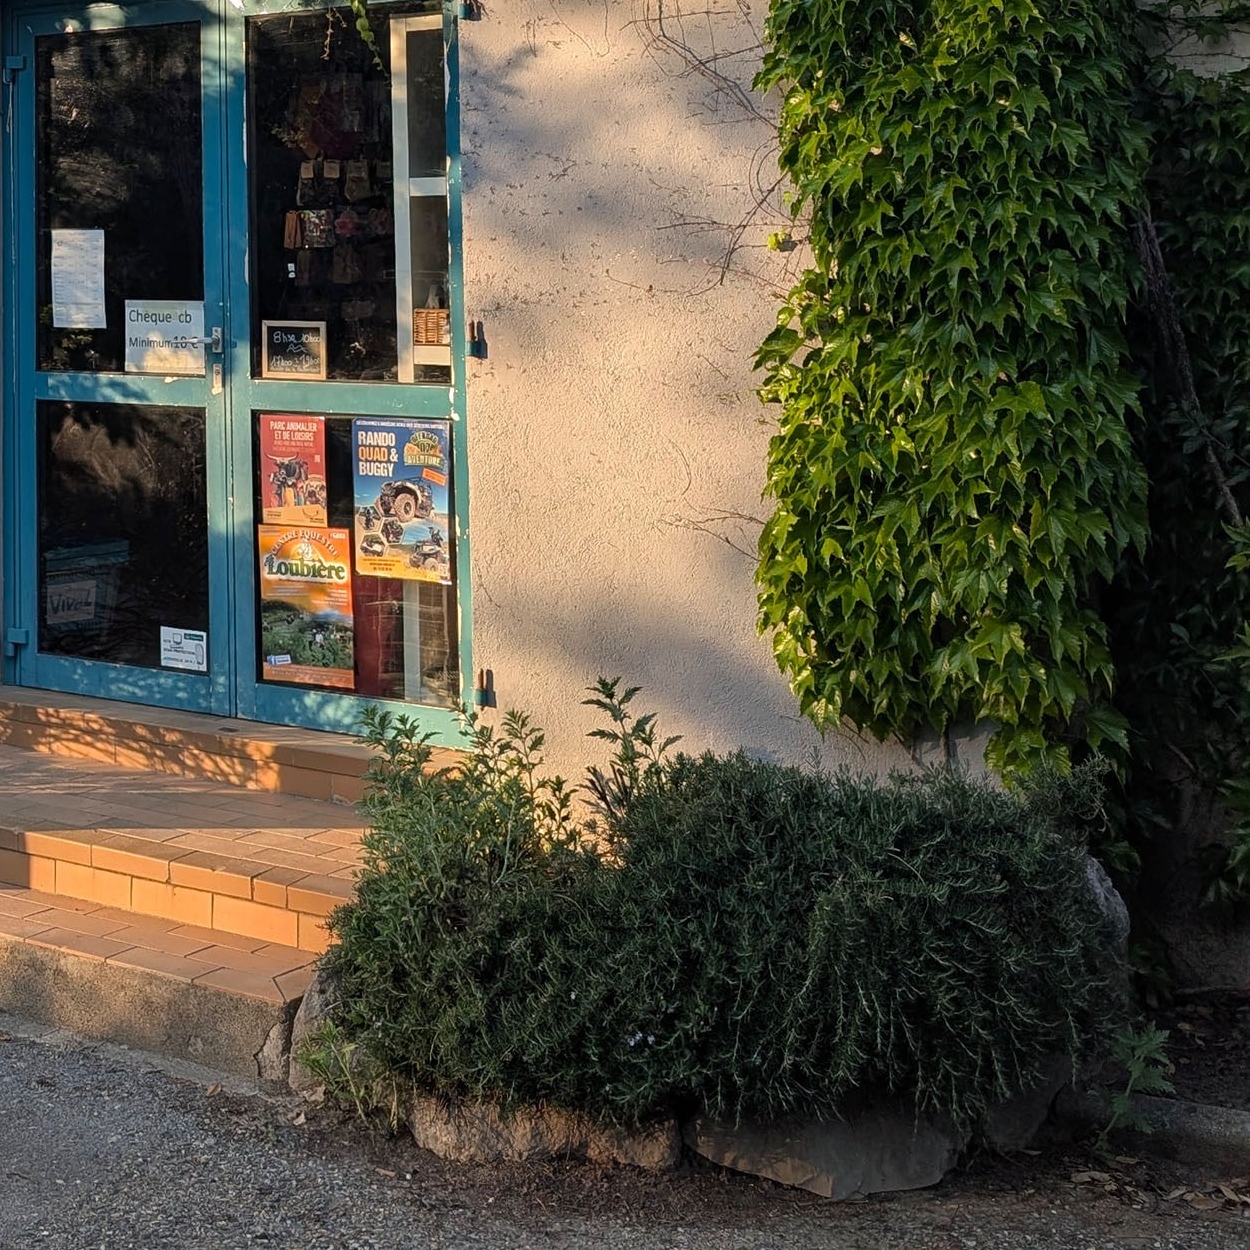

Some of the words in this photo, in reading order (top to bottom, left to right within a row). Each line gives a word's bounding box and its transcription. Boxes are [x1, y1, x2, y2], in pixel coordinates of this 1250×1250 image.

[128, 309, 172, 326] Chèque
[178, 309, 192, 324] cb
[128, 336, 173, 349] Minimum
[269, 421, 286, 431] PARC
[286, 422, 318, 432] ANIMALIER
[357, 431, 396, 447] RANDO
[358, 446, 388, 462] QUAD
[389, 448, 398, 462] &
[358, 461, 395, 477] BUGGY
[266, 557, 346, 580] Loubière
